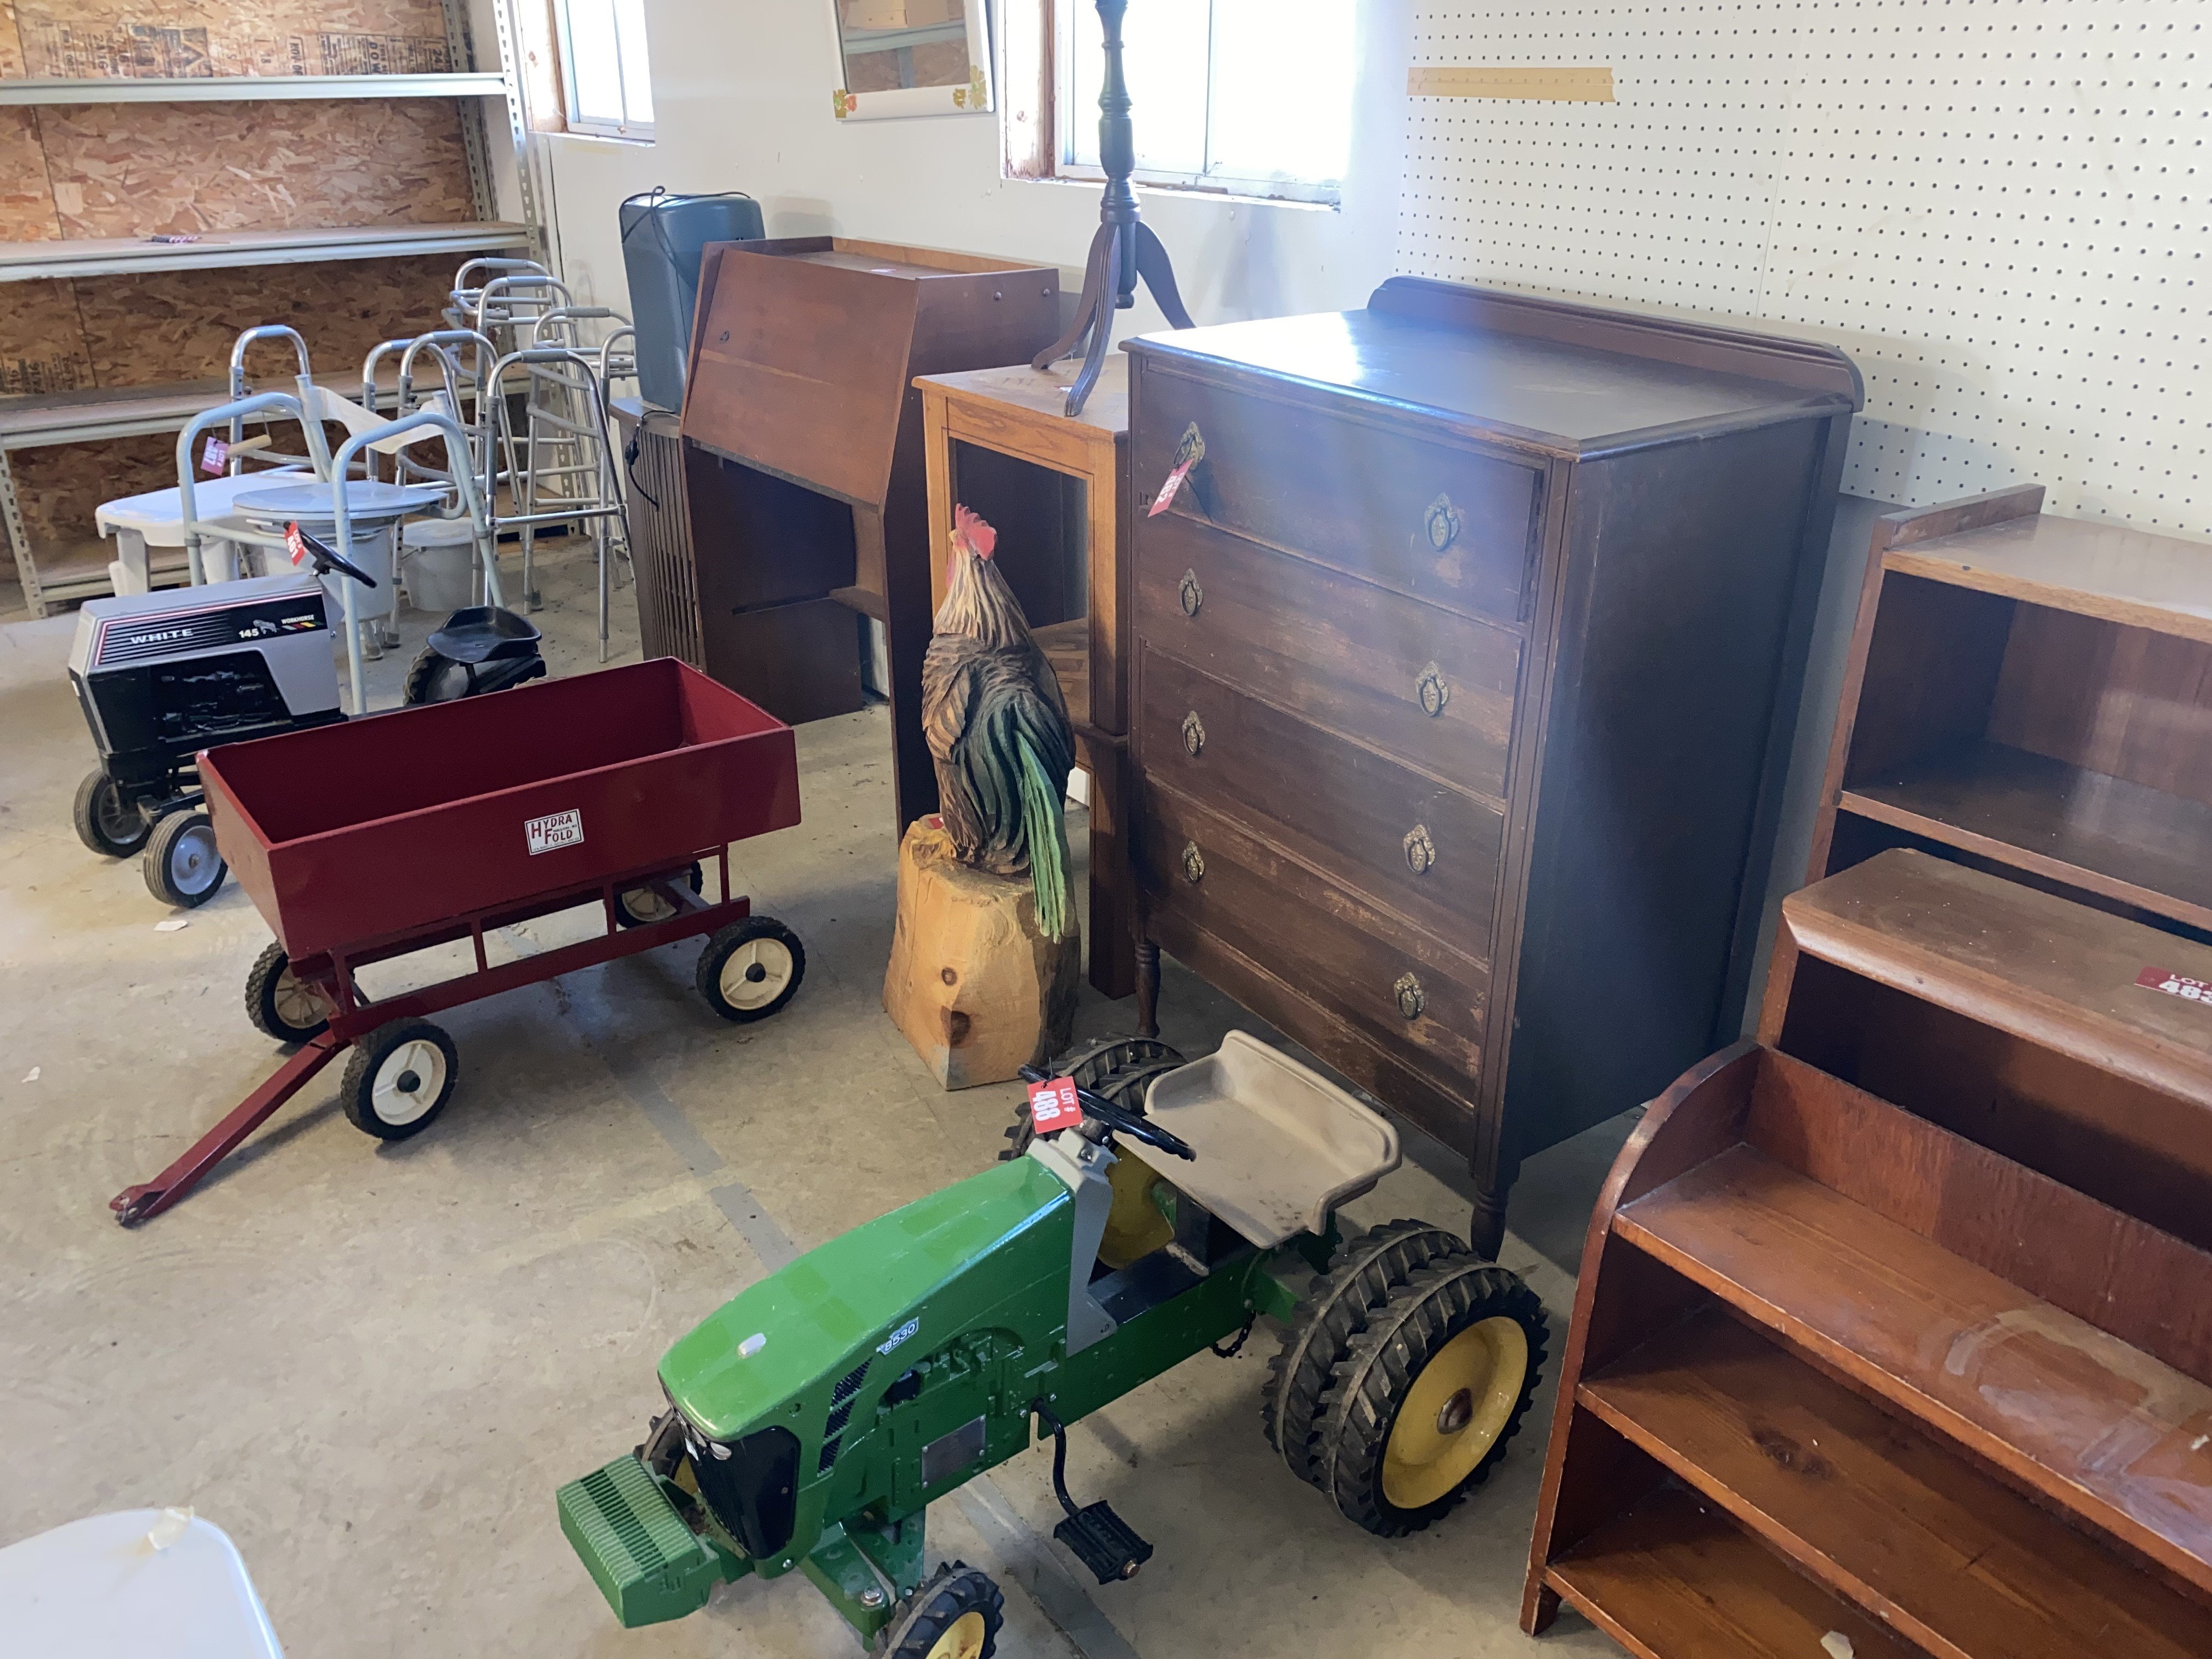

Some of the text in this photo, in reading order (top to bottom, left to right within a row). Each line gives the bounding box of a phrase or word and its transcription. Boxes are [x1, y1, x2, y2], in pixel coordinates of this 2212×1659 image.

[369, 42, 381, 74] DOW
[204, 445, 218, 465] 487
[1172, 472, 1185, 489] LOT
[1154, 475, 1178, 505] 482
[281, 614, 315, 624] WORKHORSE
[130, 628, 194, 644] WHITE
[239, 628, 259, 638] 145
[531, 814, 572, 839] HYDRA
[545, 828, 573, 844] FOLD
[2170, 974, 2209, 988] LOT
[1059, 1087, 1075, 1105] LOT
[1032, 1091, 1061, 1121] 488
[884, 1323, 916, 1351] 8530
